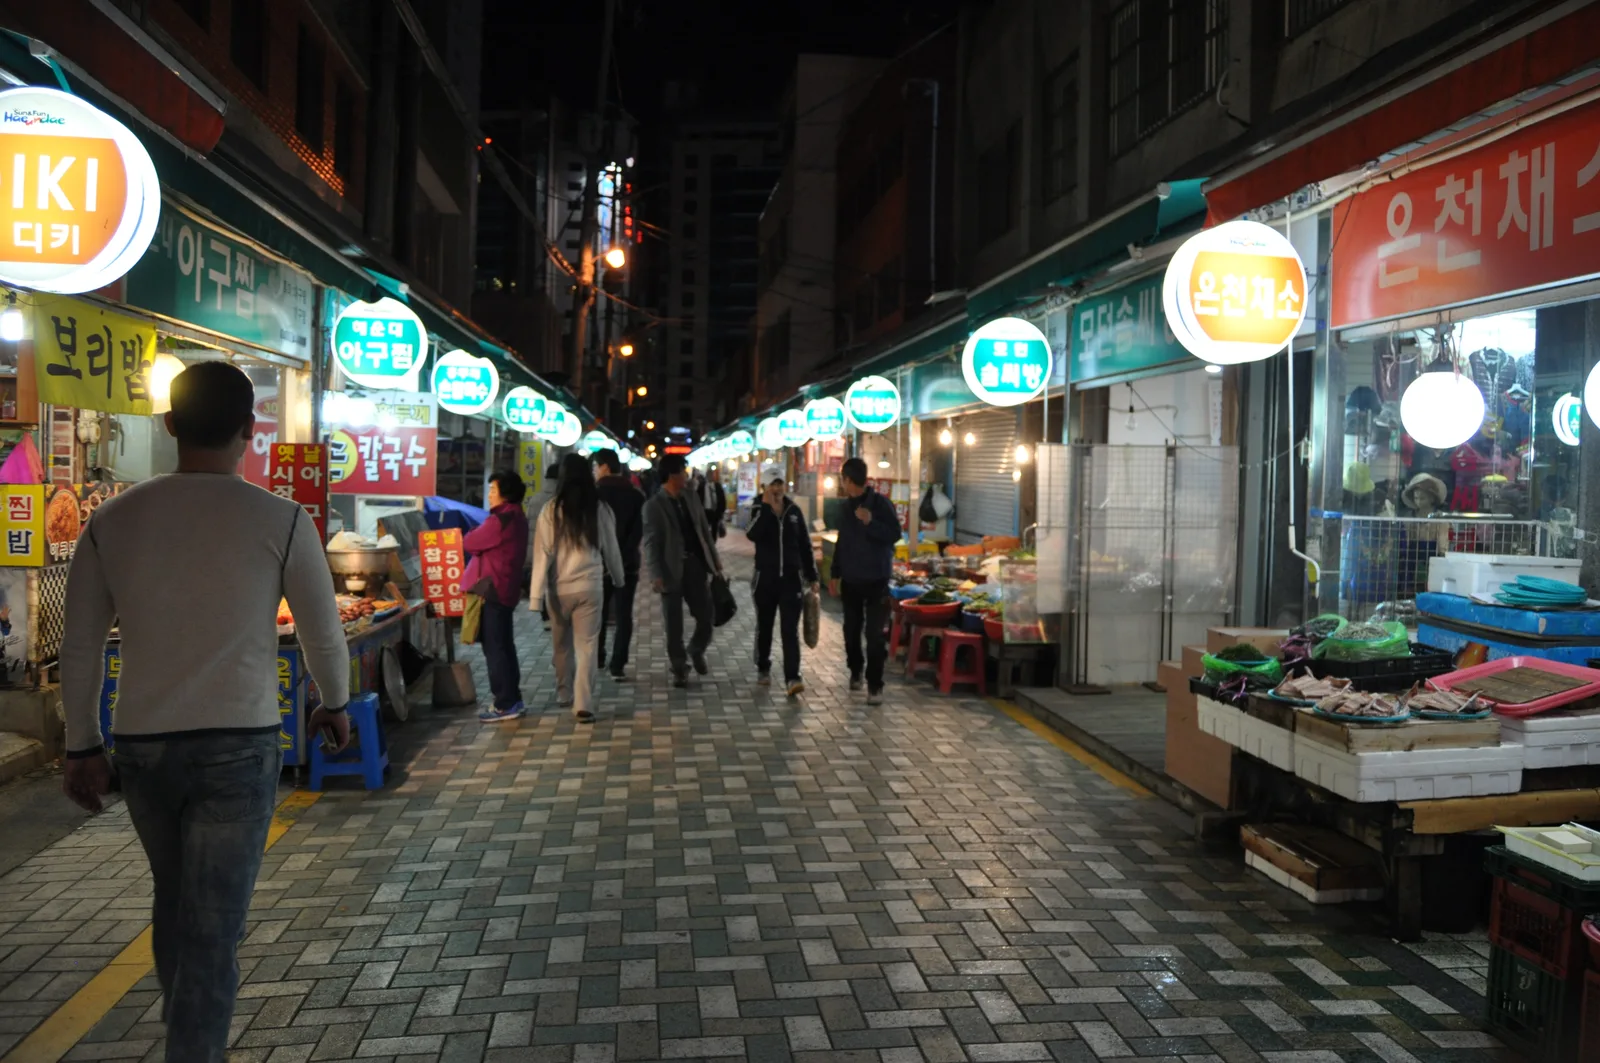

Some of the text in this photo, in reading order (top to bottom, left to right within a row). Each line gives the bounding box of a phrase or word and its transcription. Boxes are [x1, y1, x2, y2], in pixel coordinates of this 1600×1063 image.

[4, 111, 66, 126] Haeundae
[0, 153, 99, 212] IKI
[13, 221, 80, 256] 디키
[177, 224, 255, 321] 아구찜
[1194, 271, 1300, 320] 온천채소
[1079, 285, 1174, 363] 모던솜씨
[46, 315, 152, 402] 보리밥
[338, 341, 414, 369] 아구찜
[277, 444, 321, 464] 옛날
[358, 435, 428, 482] 칼국수
[5, 496, 32, 522] 찜
